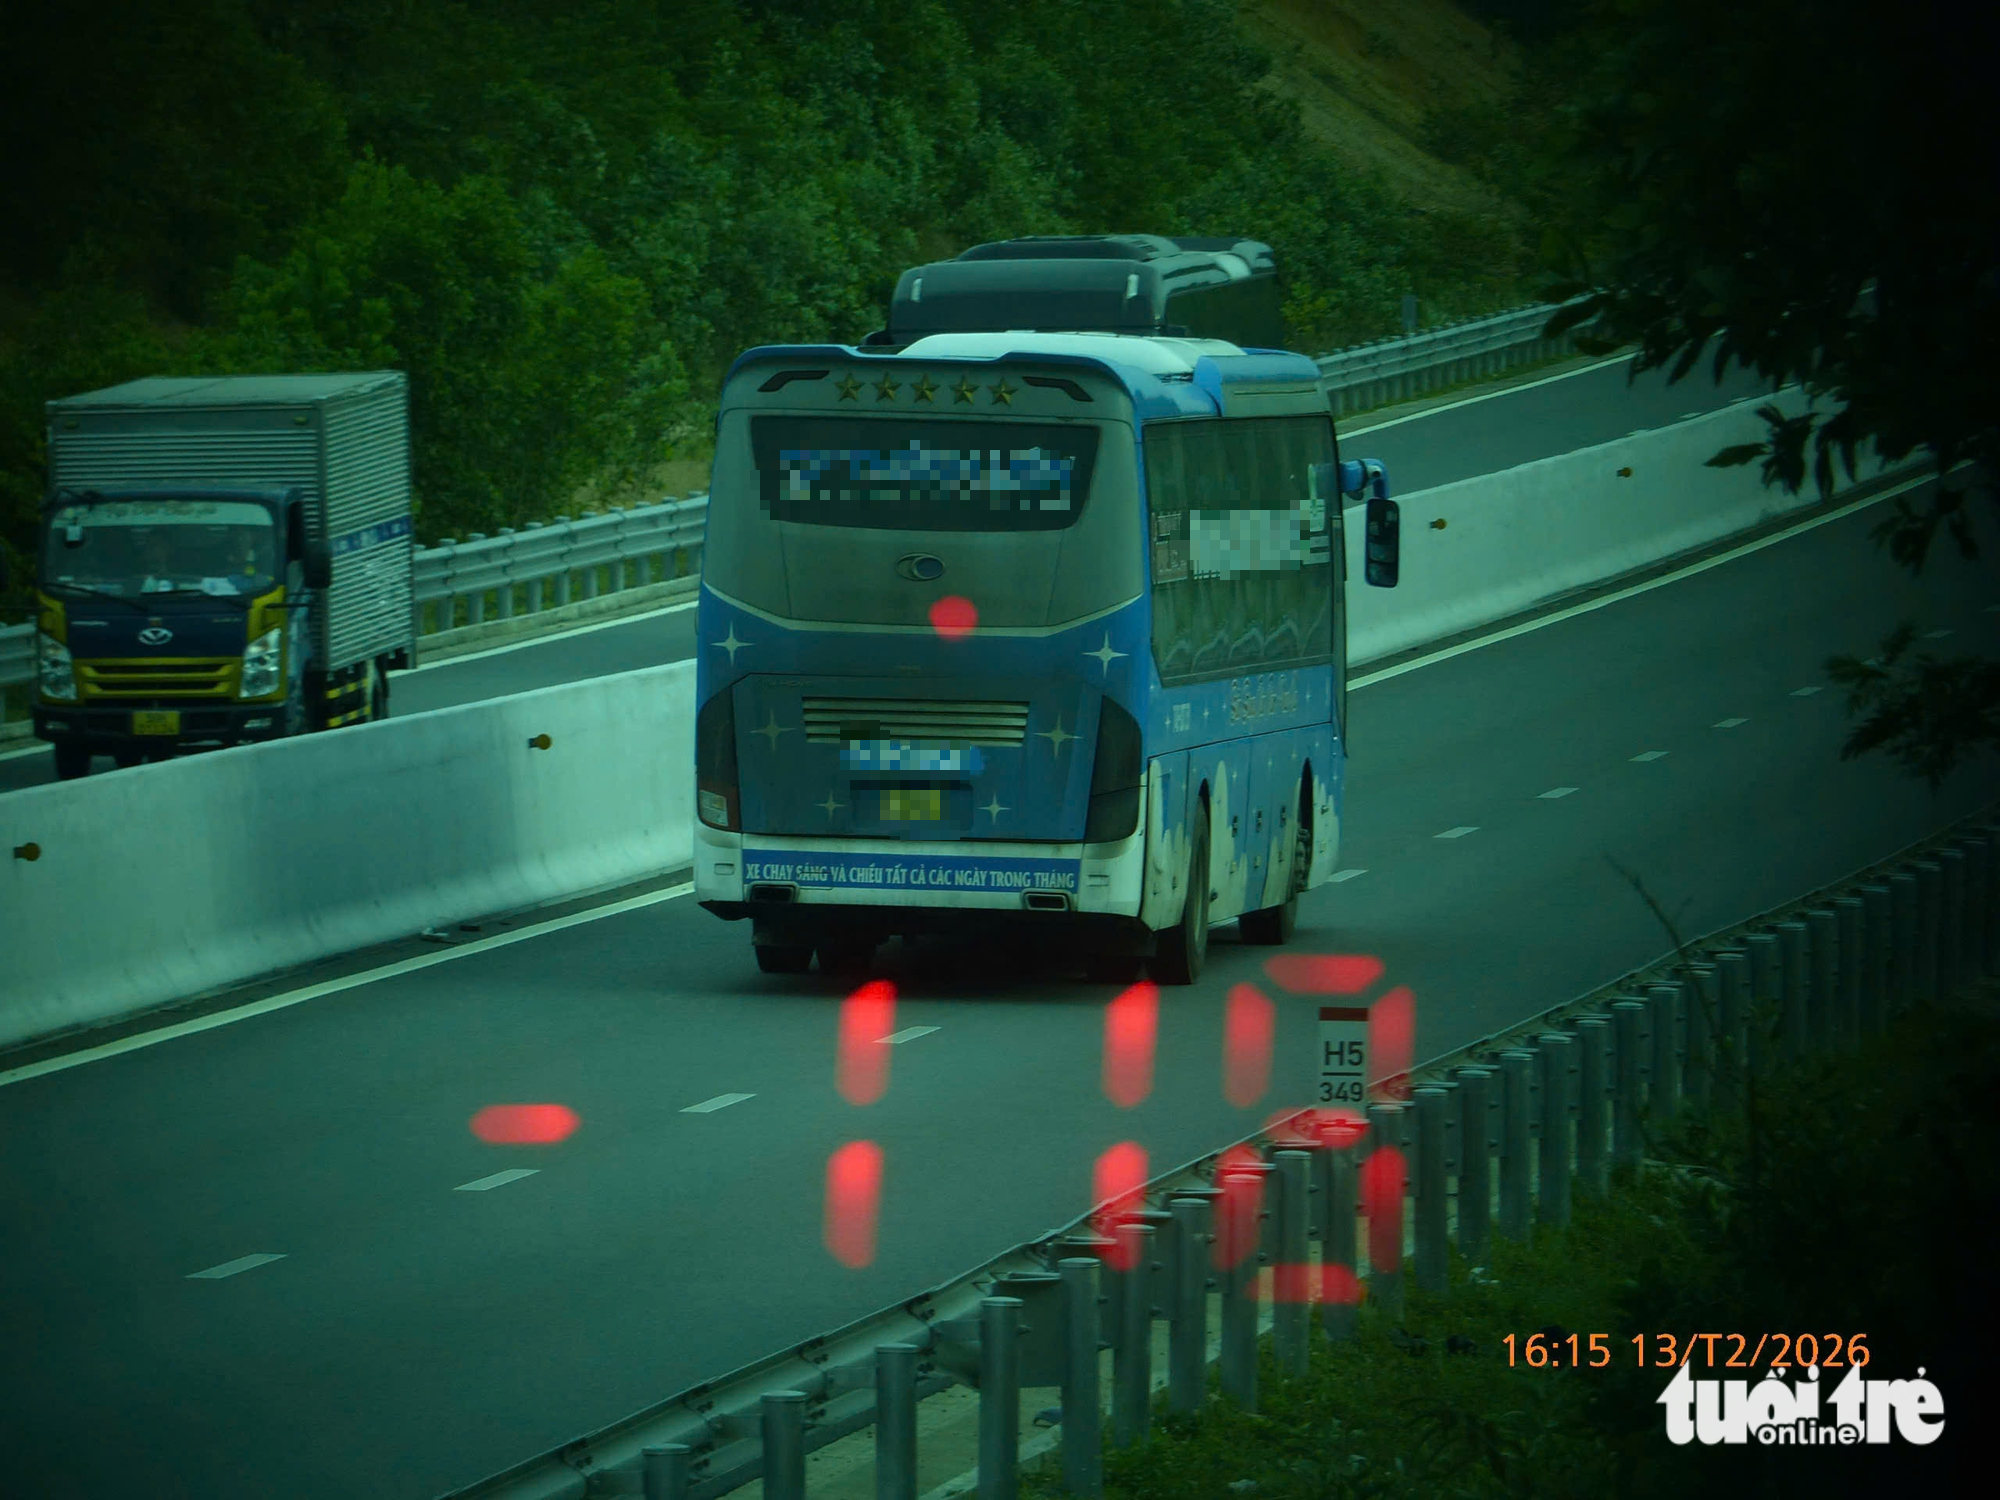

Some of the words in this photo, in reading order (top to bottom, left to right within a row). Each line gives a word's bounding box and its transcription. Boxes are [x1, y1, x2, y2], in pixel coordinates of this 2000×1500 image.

[745, 863, 760, 880] XE
[796, 861, 828, 882] SÁNG
[830, 862, 847, 883] VÀ
[886, 862, 907, 885] TẤT
[910, 863, 926, 885] CẢ
[928, 865, 953, 886] CÁC
[954, 866, 988, 887] NGÀY
[990, 870, 1031, 888] TRONG
[1033, 868, 1075, 889] THÁNG
[1323, 1040, 1364, 1067] H5
[1318, 1081, 1364, 1103] 349
